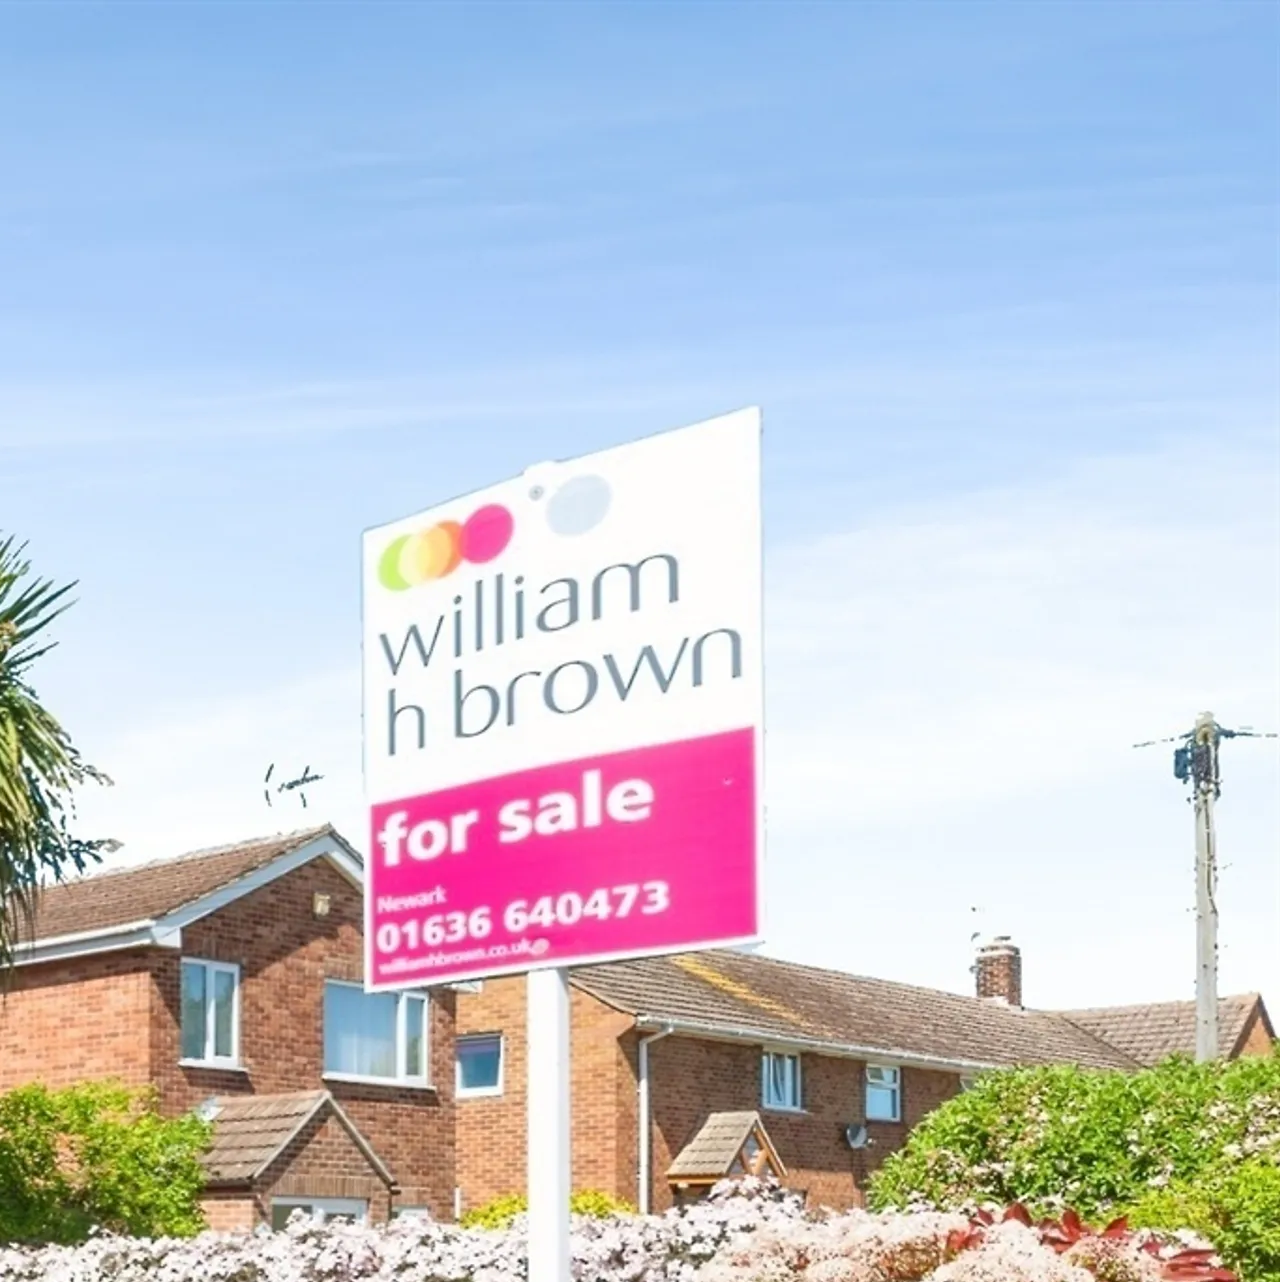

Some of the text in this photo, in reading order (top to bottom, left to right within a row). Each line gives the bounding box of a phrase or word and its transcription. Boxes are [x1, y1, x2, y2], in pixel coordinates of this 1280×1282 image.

[379, 552, 679, 675] william
[389, 628, 742, 756] h brown
[378, 769, 654, 866] for sale
[377, 886, 446, 913] Newark
[377, 881, 669, 953] 01636 640473
